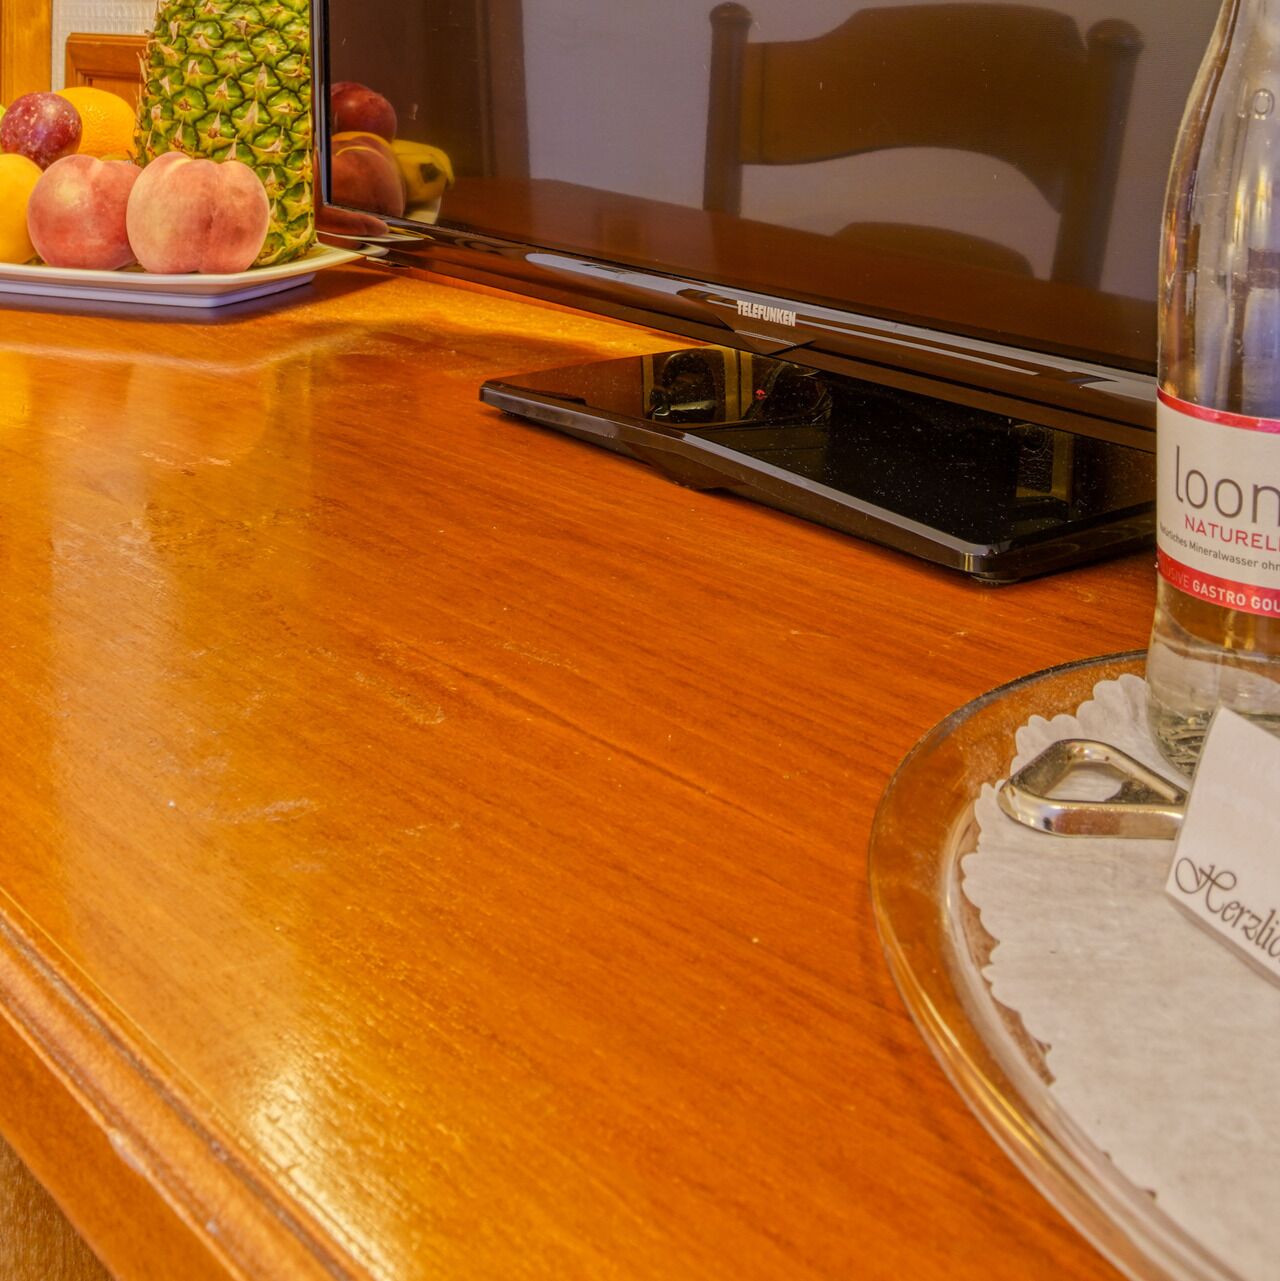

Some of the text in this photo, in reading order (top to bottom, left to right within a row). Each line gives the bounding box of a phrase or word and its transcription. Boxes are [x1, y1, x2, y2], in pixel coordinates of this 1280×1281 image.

[736, 299, 797, 327] TELEFUNKEN
[1188, 539, 1259, 569] Mineralwasser
[1191, 578, 1247, 607] GASTRO
